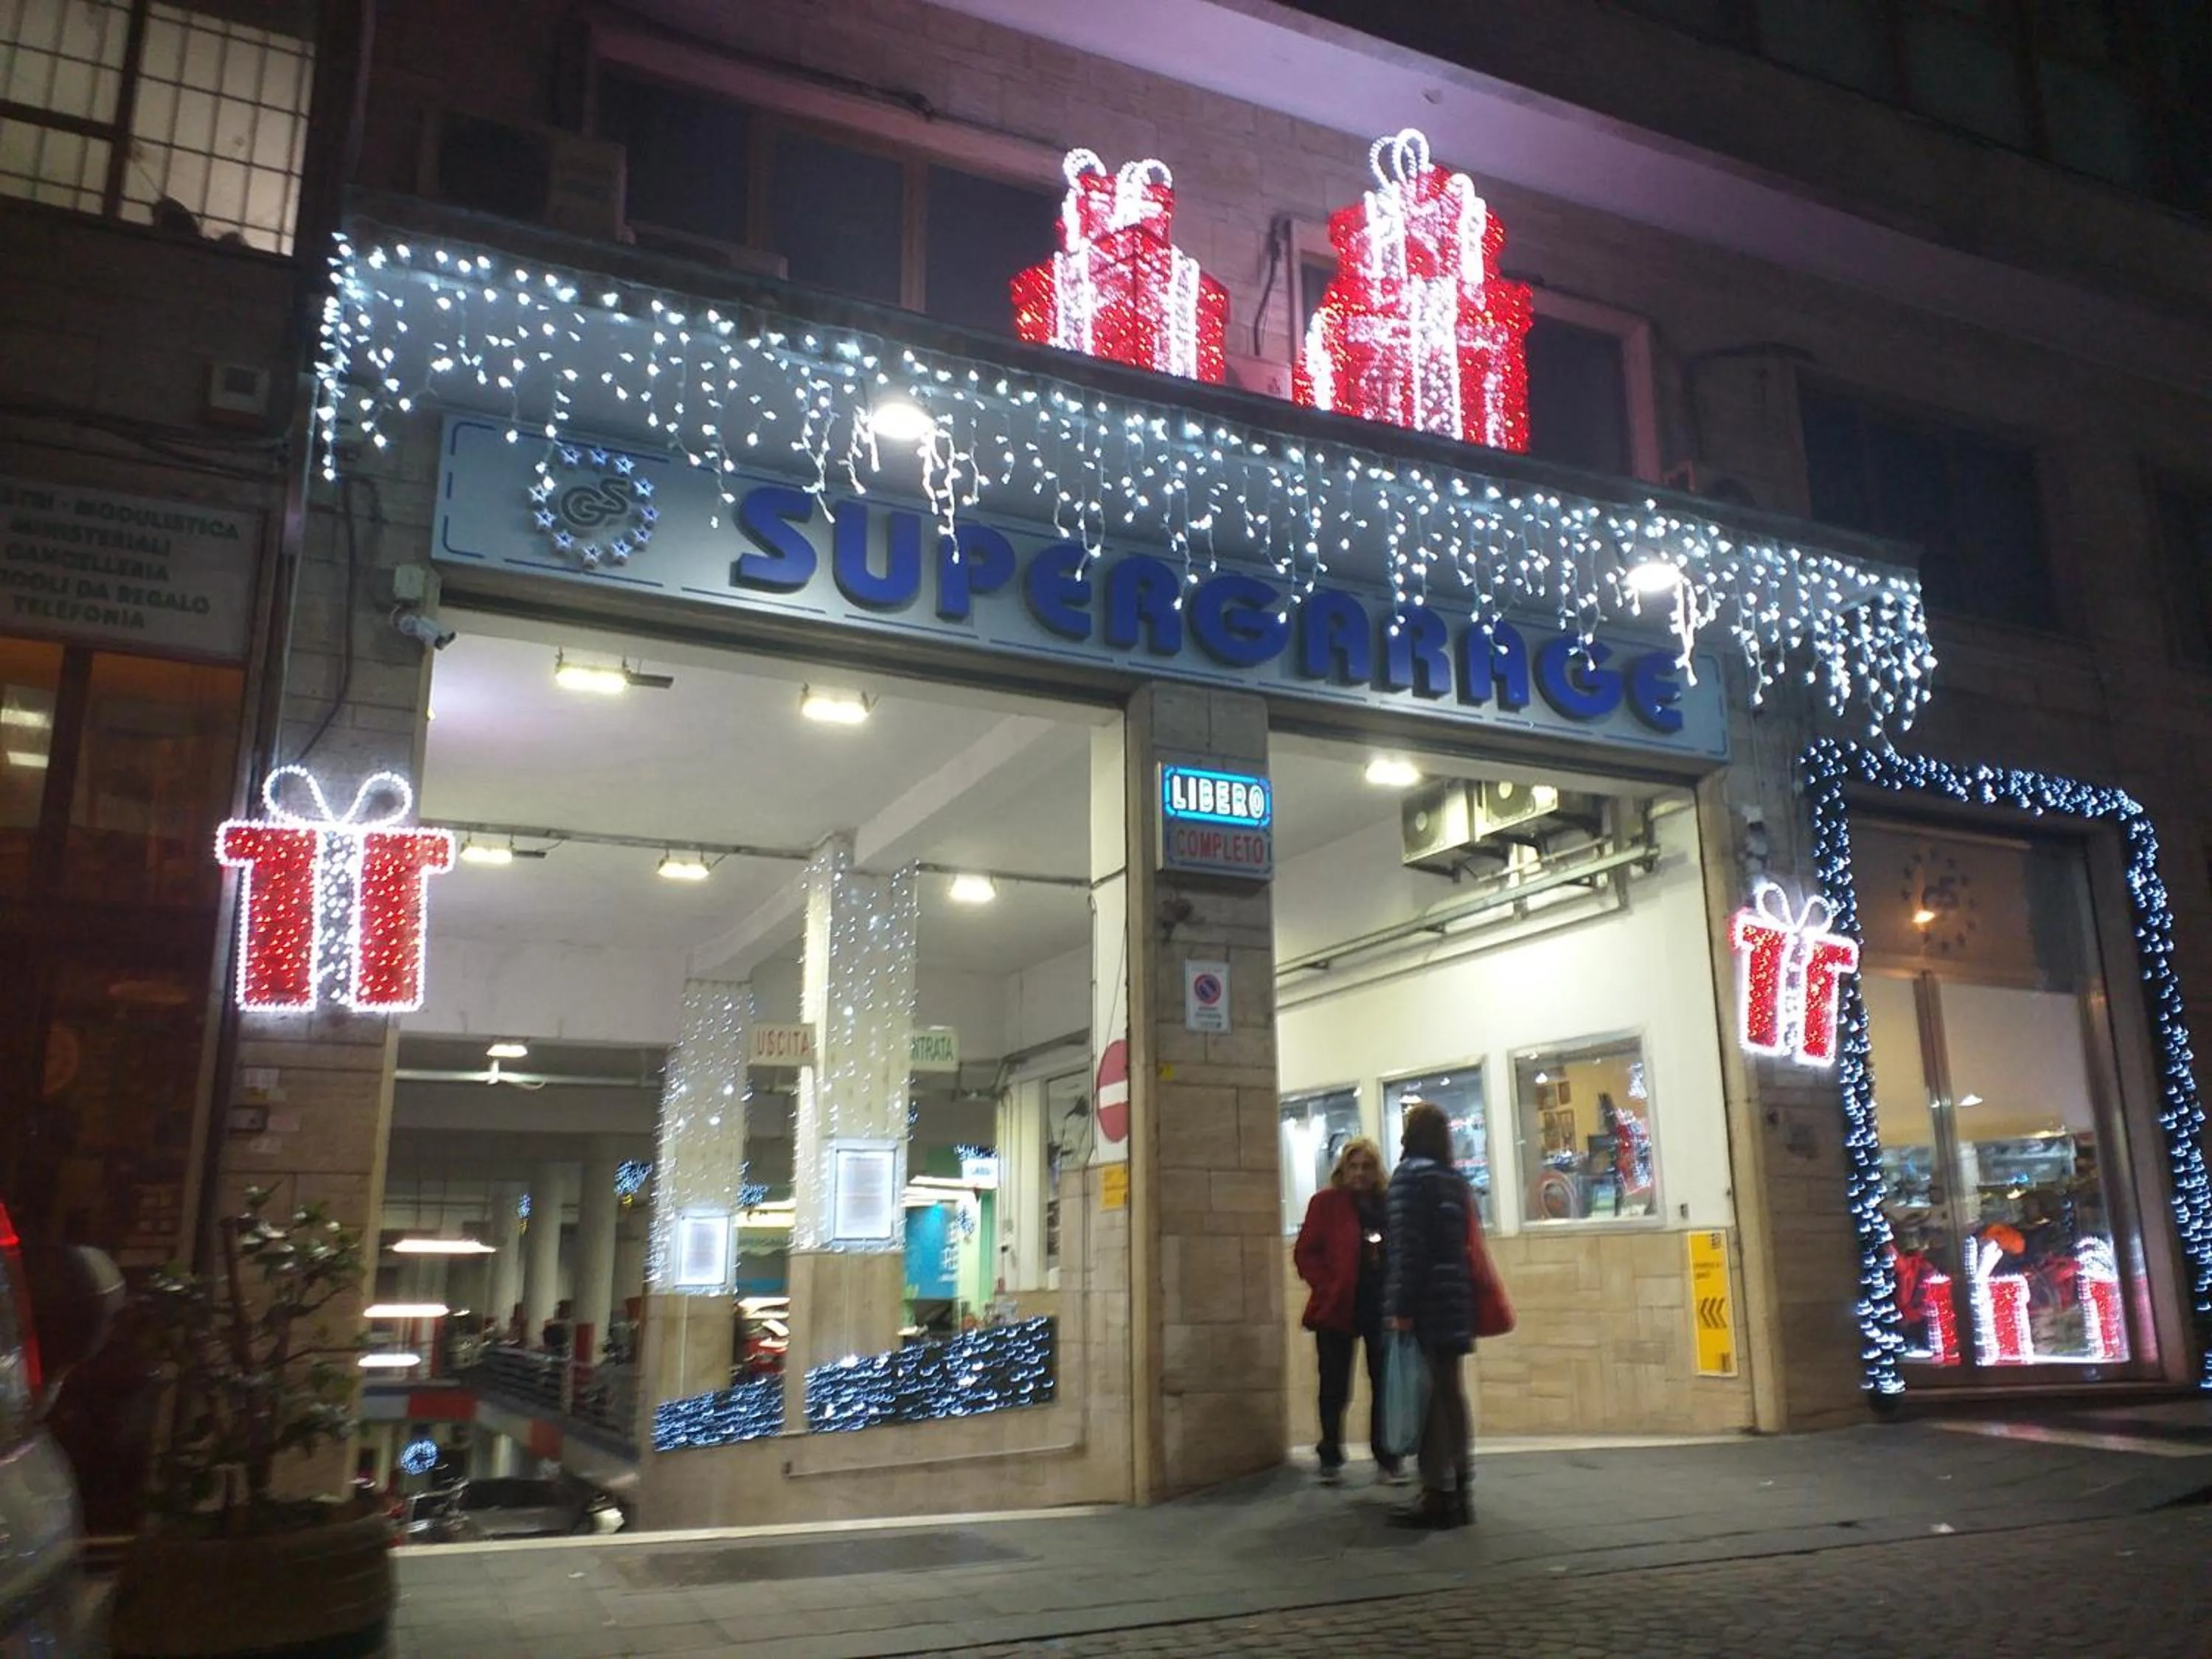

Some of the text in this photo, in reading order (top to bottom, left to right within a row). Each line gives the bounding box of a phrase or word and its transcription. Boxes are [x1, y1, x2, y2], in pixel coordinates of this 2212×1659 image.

[13, 594, 145, 629] TELEFONIA
[116, 585, 211, 614] REGALO
[731, 486, 1684, 731] SUPERGARAGE
[1172, 776, 1265, 818] LIBERO
[1176, 830, 1264, 864] COMPLETO
[756, 1030, 810, 1057] USCITA
[911, 1035, 954, 1062] NTRATA
